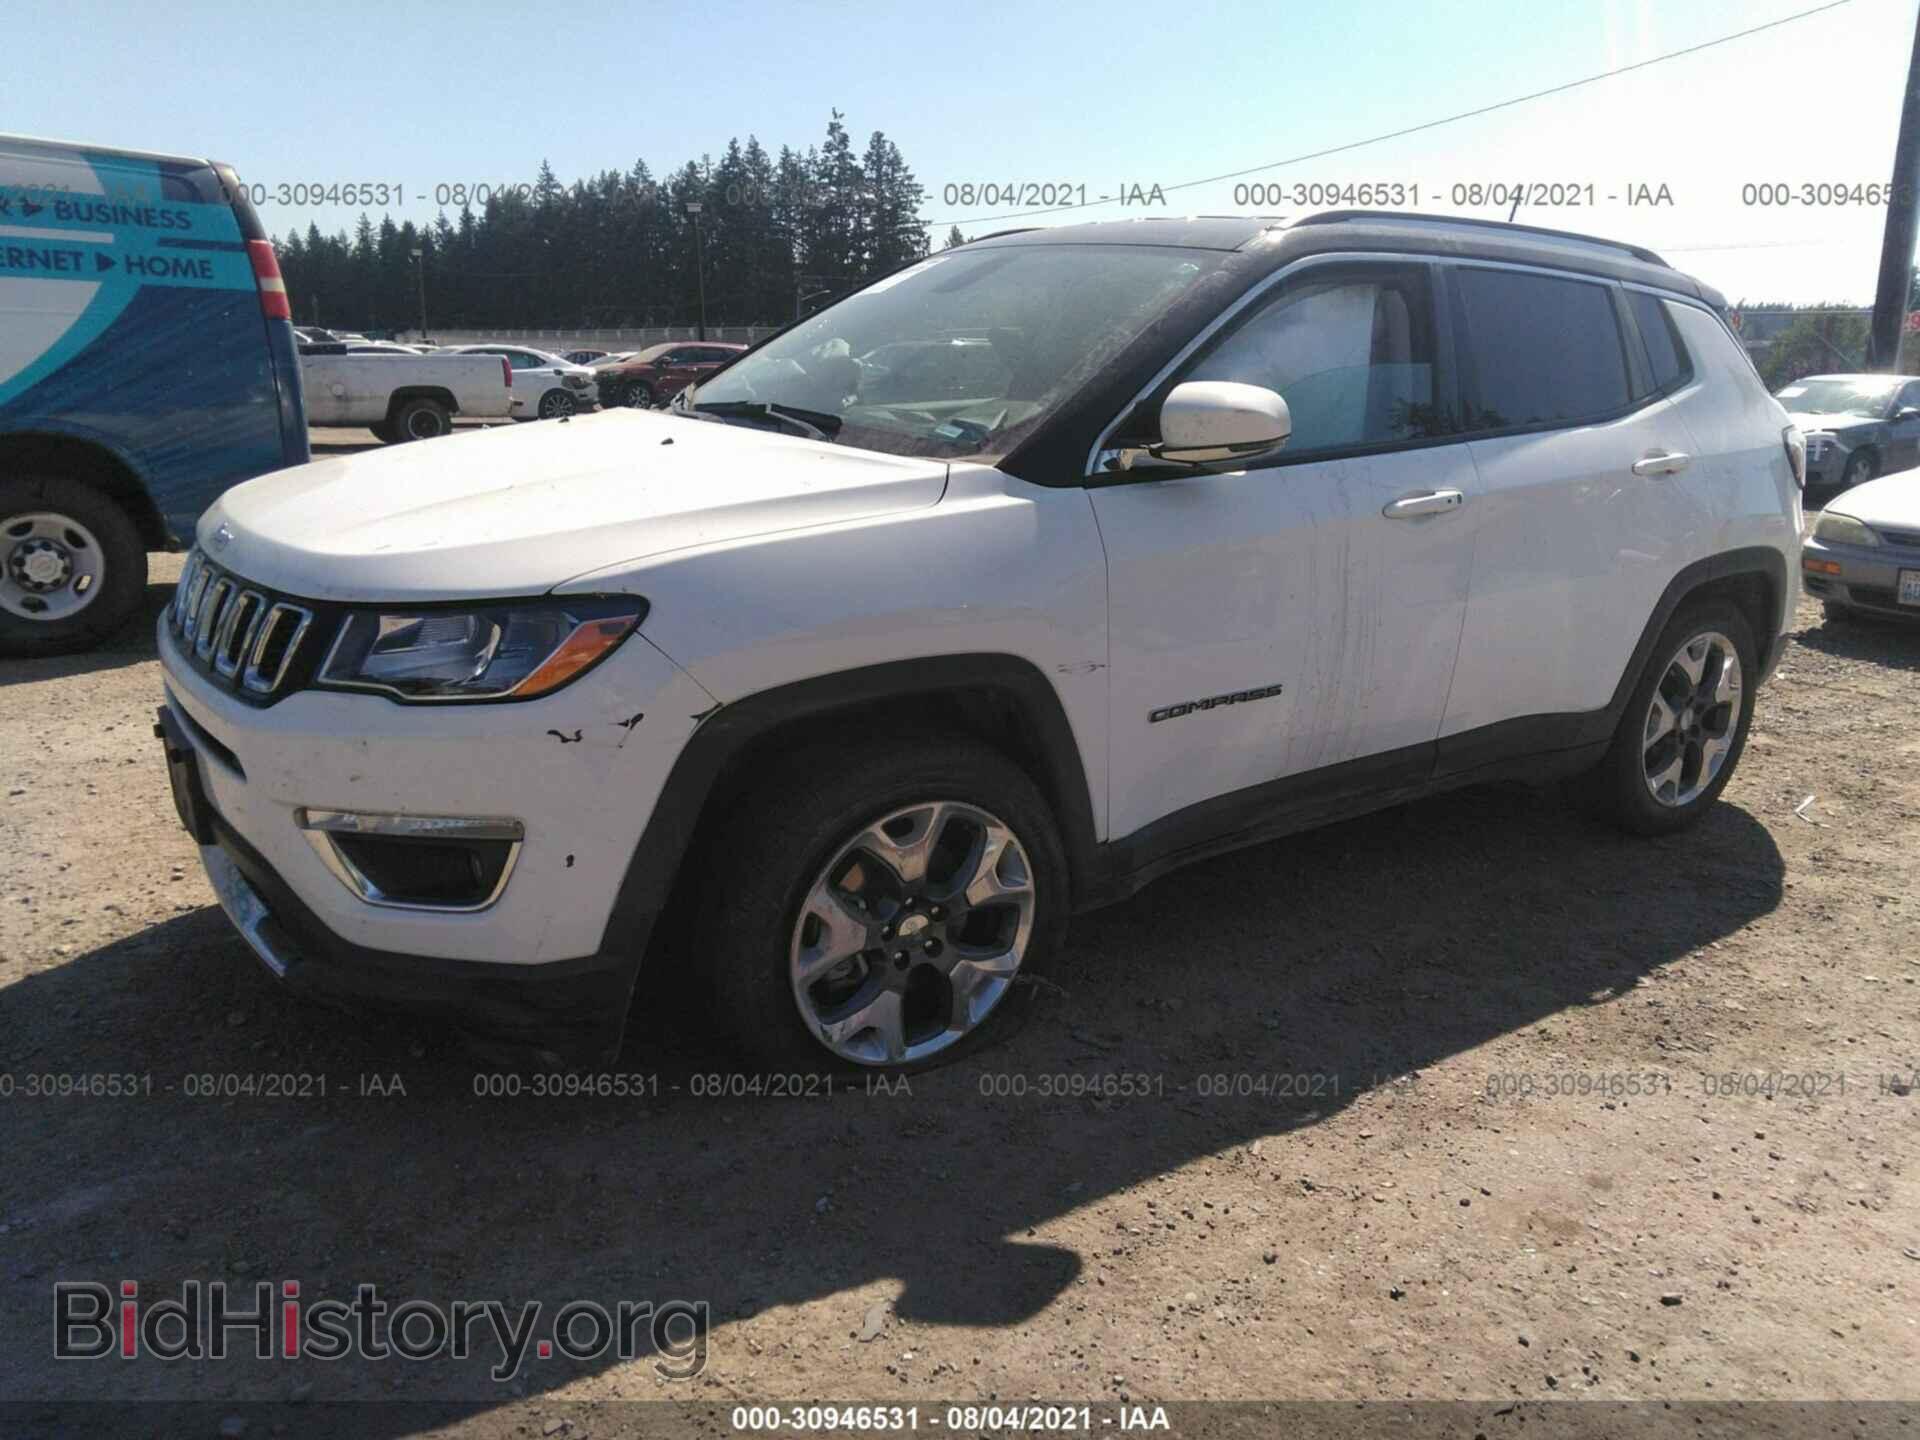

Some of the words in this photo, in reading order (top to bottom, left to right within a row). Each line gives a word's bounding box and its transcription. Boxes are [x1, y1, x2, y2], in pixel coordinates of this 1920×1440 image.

[54, 200, 193, 230] BUSINESS
[124, 255, 214, 279] HOME
[1149, 683, 1284, 724] COMPASS
